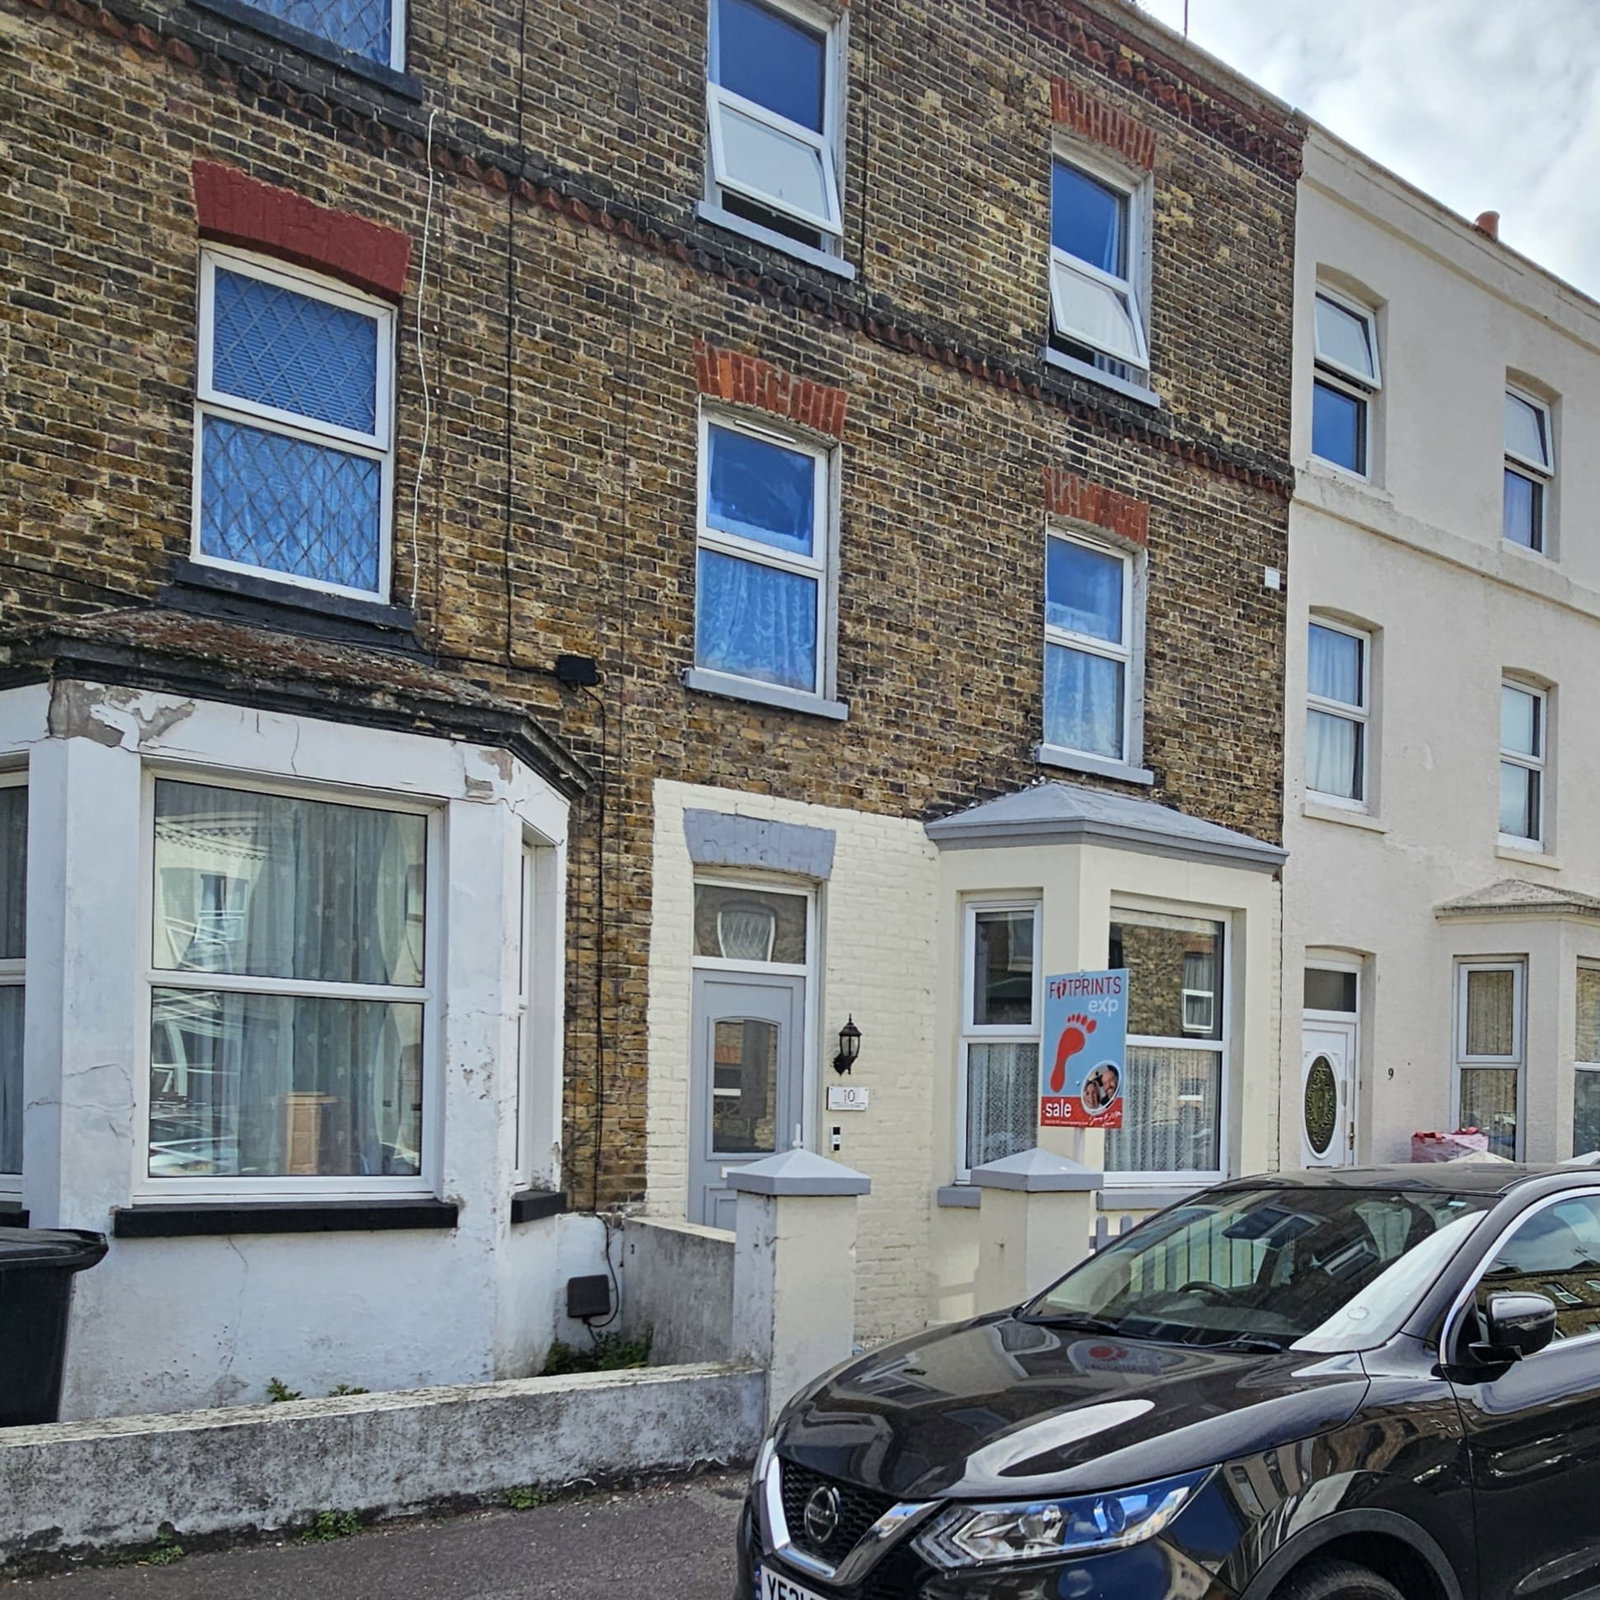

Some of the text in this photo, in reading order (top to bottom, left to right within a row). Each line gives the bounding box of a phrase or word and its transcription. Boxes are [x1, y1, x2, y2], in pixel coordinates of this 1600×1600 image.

[1088, 997, 1119, 1017] exp
[1387, 1067, 1394, 1080] 9
[1045, 1098, 1072, 1118] sale
